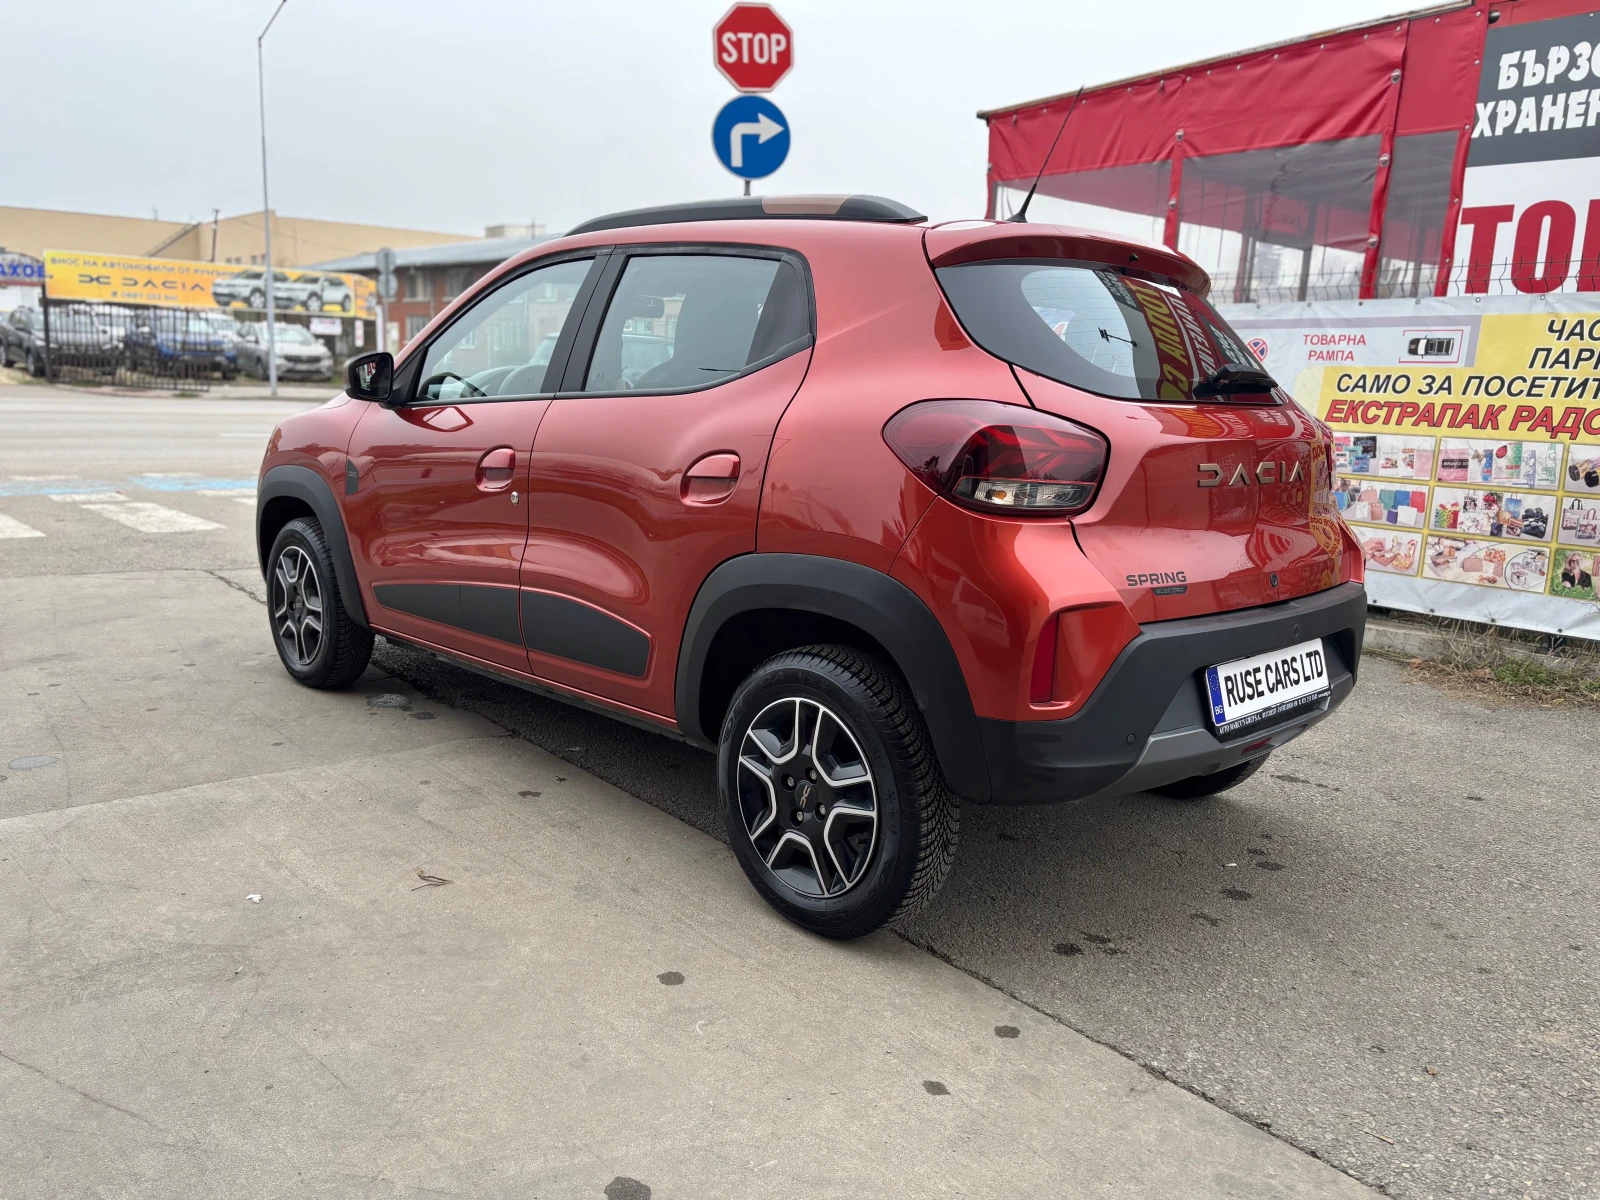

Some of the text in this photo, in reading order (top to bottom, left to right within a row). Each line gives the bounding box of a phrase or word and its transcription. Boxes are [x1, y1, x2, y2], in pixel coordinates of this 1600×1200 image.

[721, 31, 787, 65] STOP
[51, 257, 80, 267] ВНОС
[83, 258, 98, 268] НА
[102, 260, 175, 273] АВТОМОБИЛИ
[122, 277, 206, 292] DACIA
[1303, 334, 1366, 346] ТОВАРНА
[1307, 350, 1355, 361] РАМПА
[1337, 373, 1411, 395] САМО
[1417, 375, 1453, 396] ЗА
[1324, 399, 1507, 431] ЕКСТРАПАК
[1197, 460, 1305, 487] DACIA
[1126, 571, 1187, 587] SPRING
[1224, 666, 1265, 707] RUSE
[1264, 656, 1301, 694] CARS
[1300, 650, 1324, 683] LTD
[1214, 705, 1223, 715] BG
